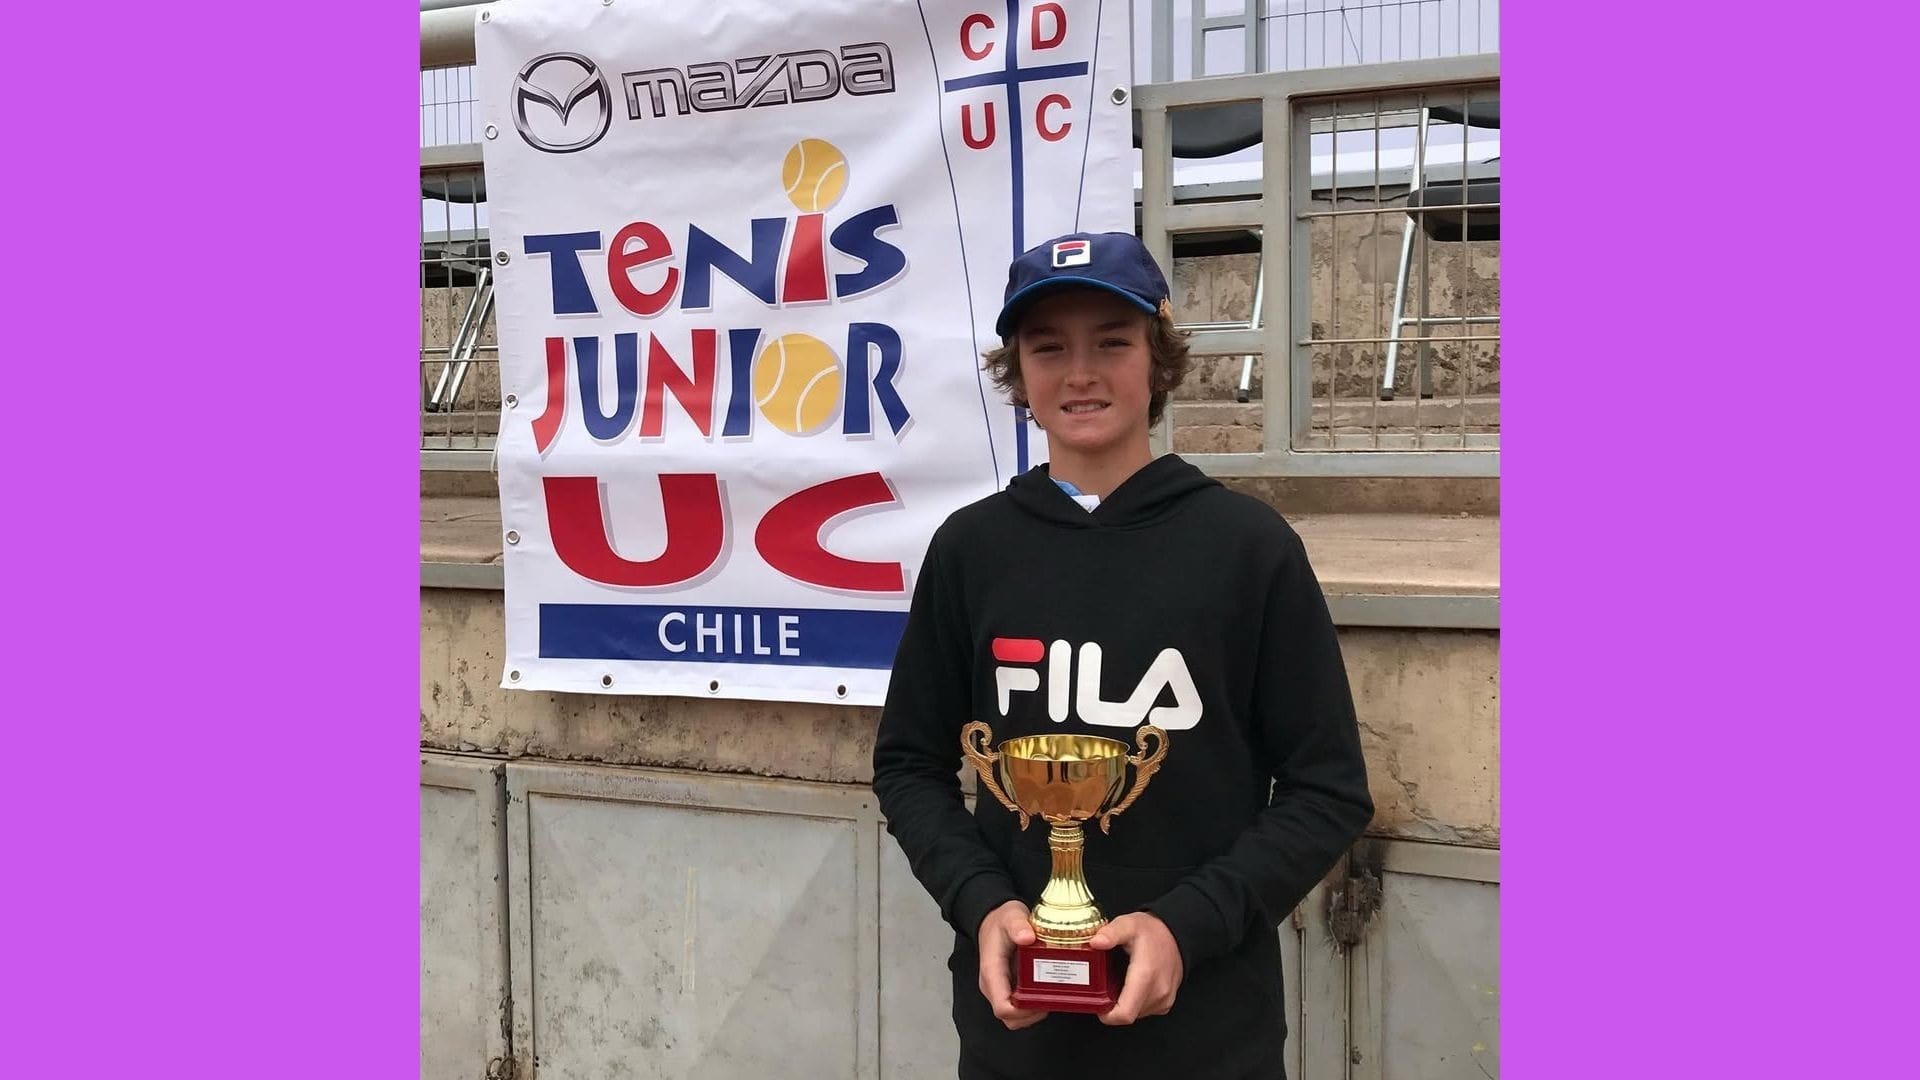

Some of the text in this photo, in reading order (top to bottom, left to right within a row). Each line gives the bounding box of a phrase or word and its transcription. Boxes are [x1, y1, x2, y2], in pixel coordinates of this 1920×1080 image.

[960, 2, 1066, 61] C D
[962, 93, 1073, 149] U C
[542, 471, 906, 592] UC
[657, 611, 801, 657] CHILE
[991, 637, 1204, 730] FILA
